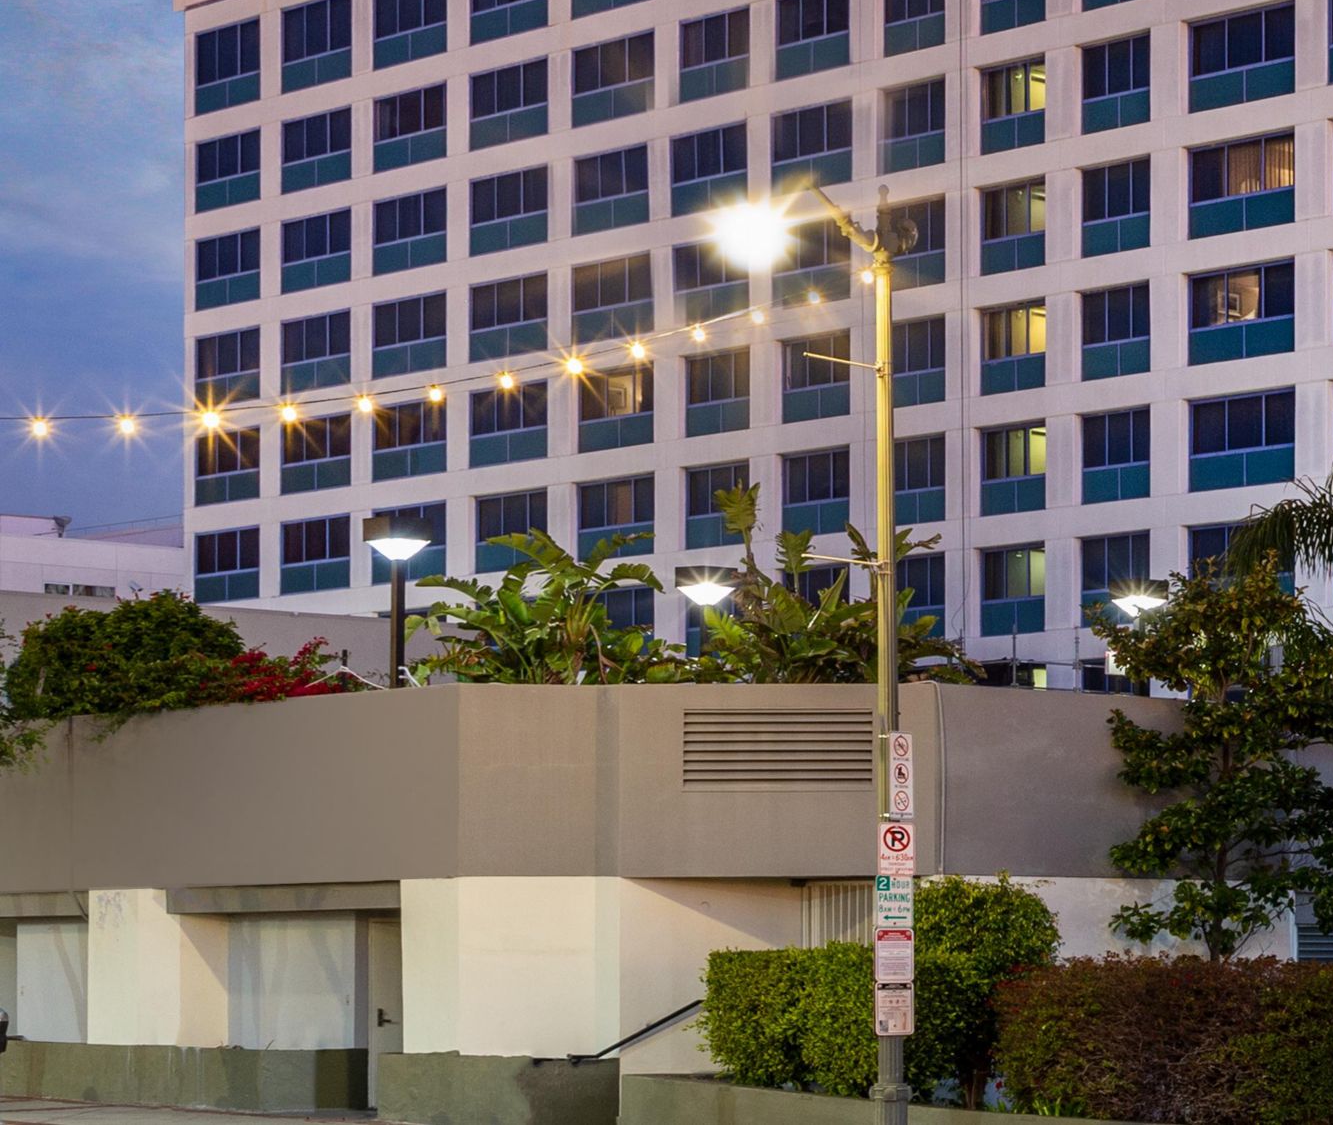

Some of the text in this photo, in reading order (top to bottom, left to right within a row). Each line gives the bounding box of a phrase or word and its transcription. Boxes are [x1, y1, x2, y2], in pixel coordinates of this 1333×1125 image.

[878, 877, 910, 889] 2 HOUR
[878, 892, 910, 903] PARKING
